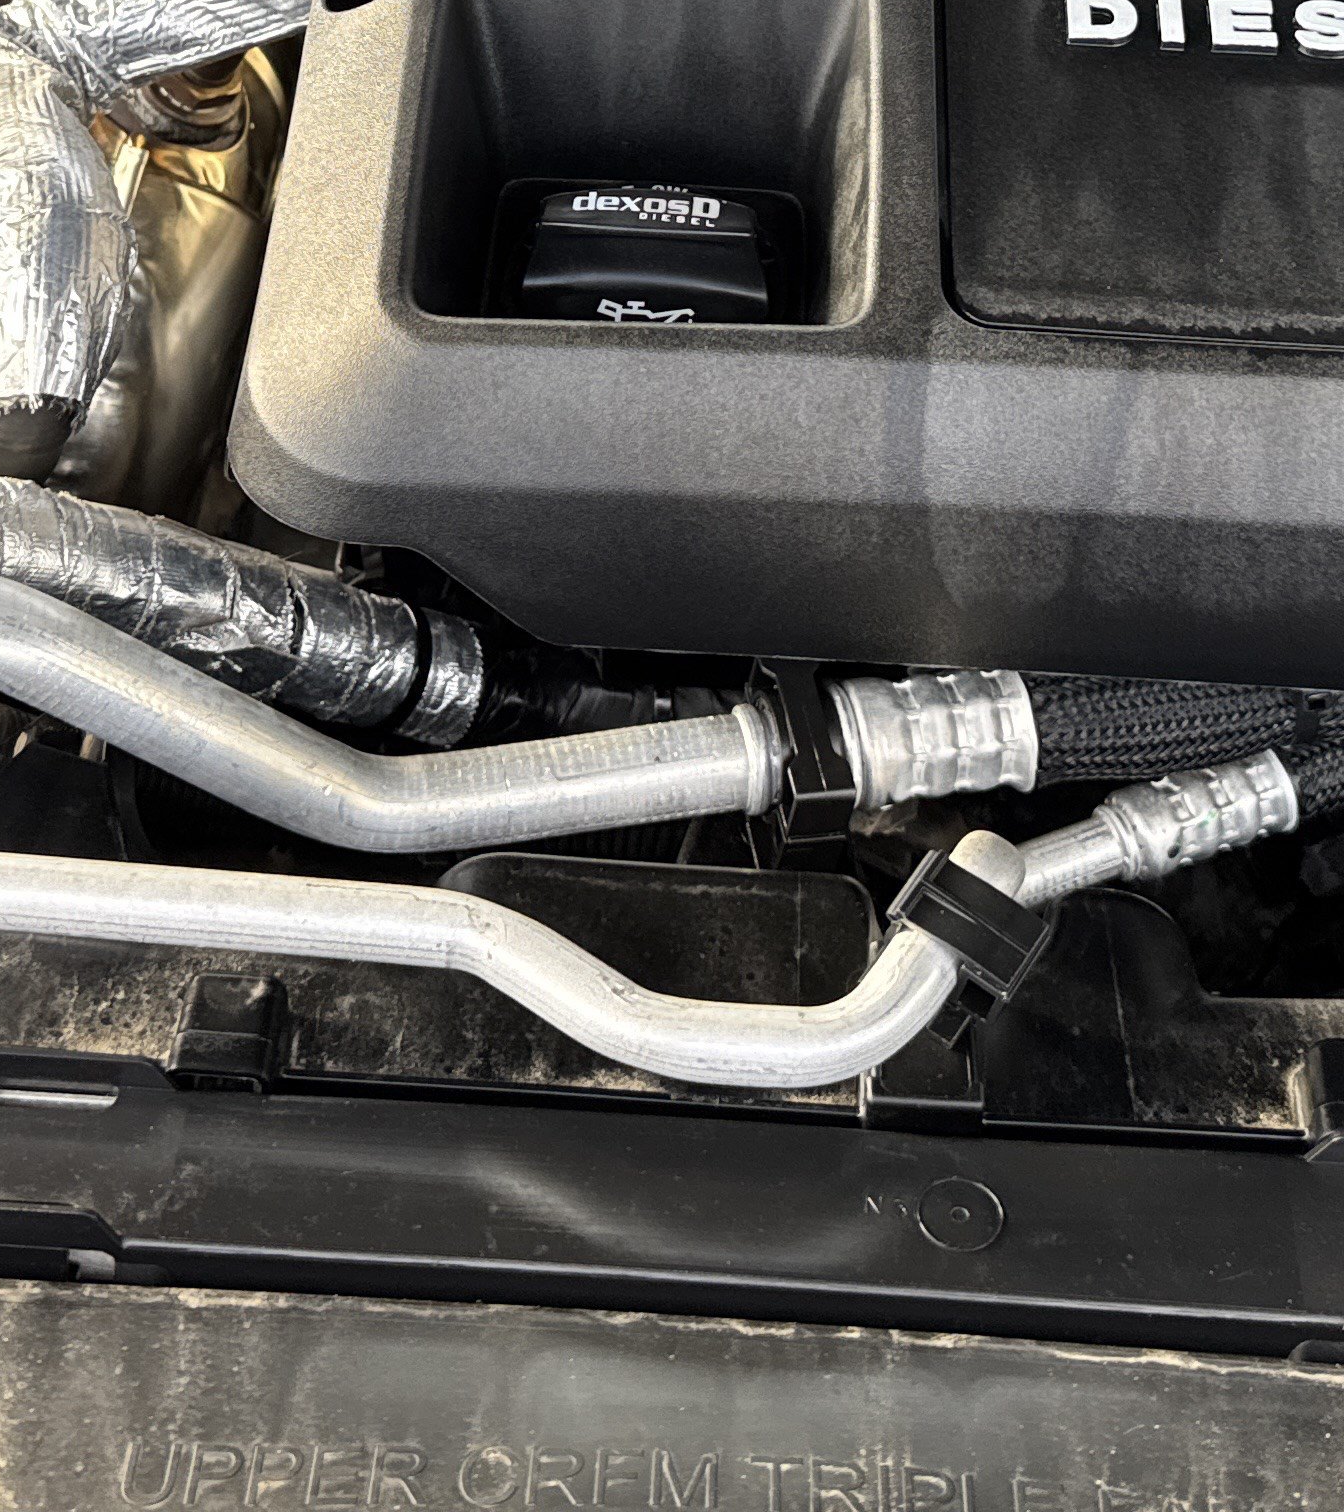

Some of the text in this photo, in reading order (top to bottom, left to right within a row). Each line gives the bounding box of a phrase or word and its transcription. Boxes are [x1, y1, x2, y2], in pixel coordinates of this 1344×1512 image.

[571, 191, 722, 219] dexosD
[637, 211, 716, 228] DIESEL
[120, 1440, 429, 1510] UPPER
